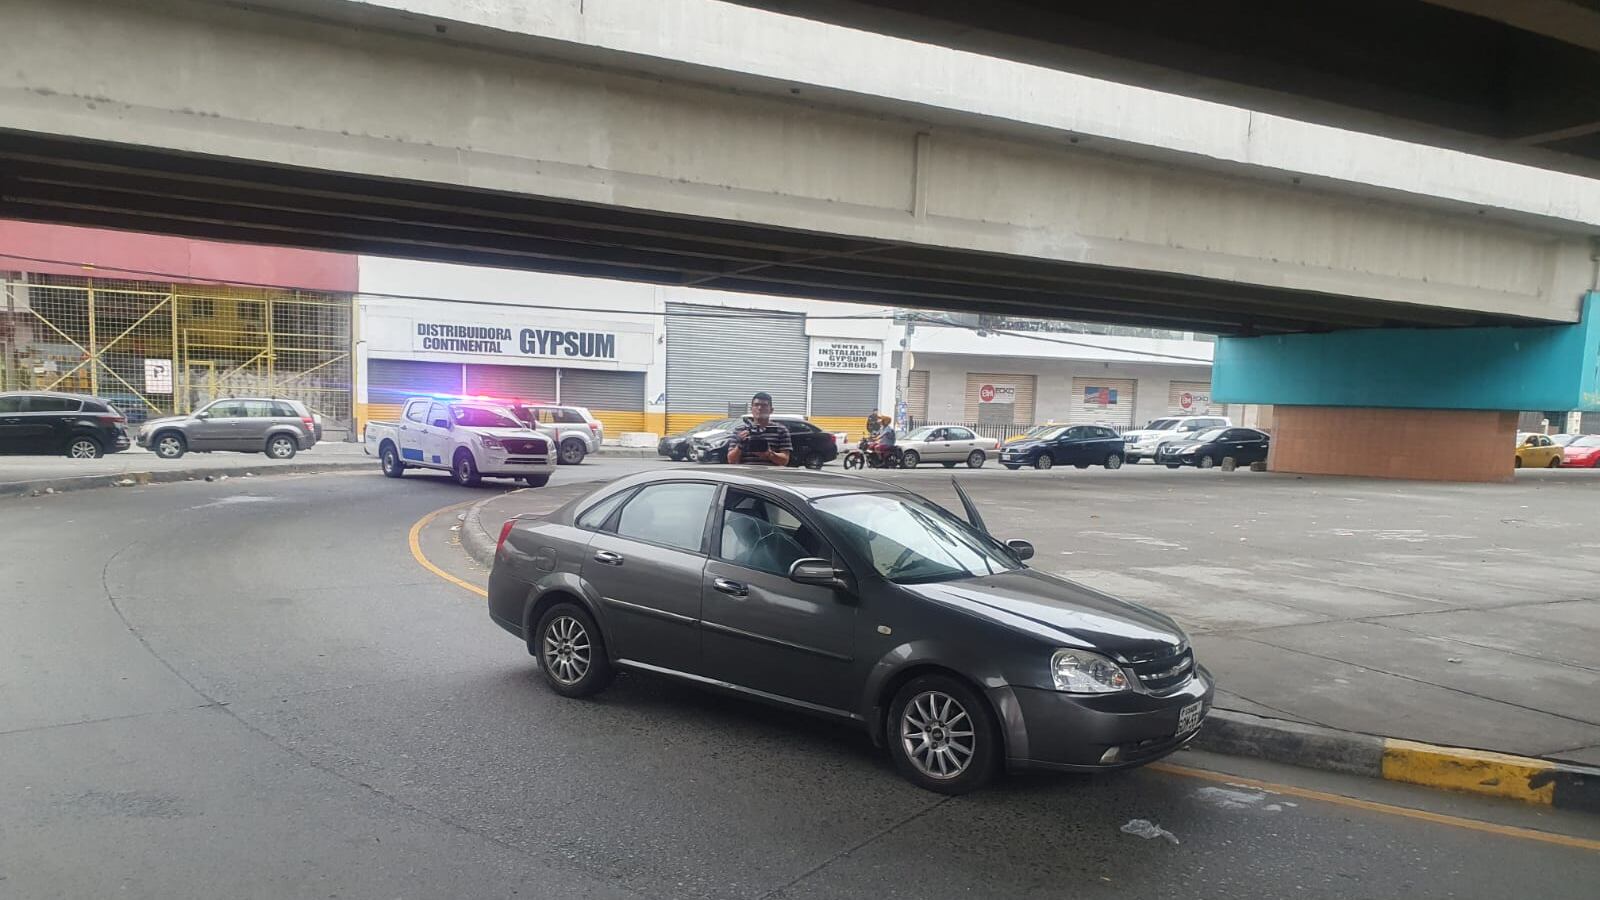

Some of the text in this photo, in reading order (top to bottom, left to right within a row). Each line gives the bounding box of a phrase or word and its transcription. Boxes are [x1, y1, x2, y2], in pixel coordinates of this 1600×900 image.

[417, 323, 512, 341] DISTRIBUIDORA
[423, 337, 503, 353] CONTINENTAL
[519, 328, 615, 358] GYPSUM
[818, 349, 877, 357] INSTALACION
[828, 355, 867, 363] GYPSUM
